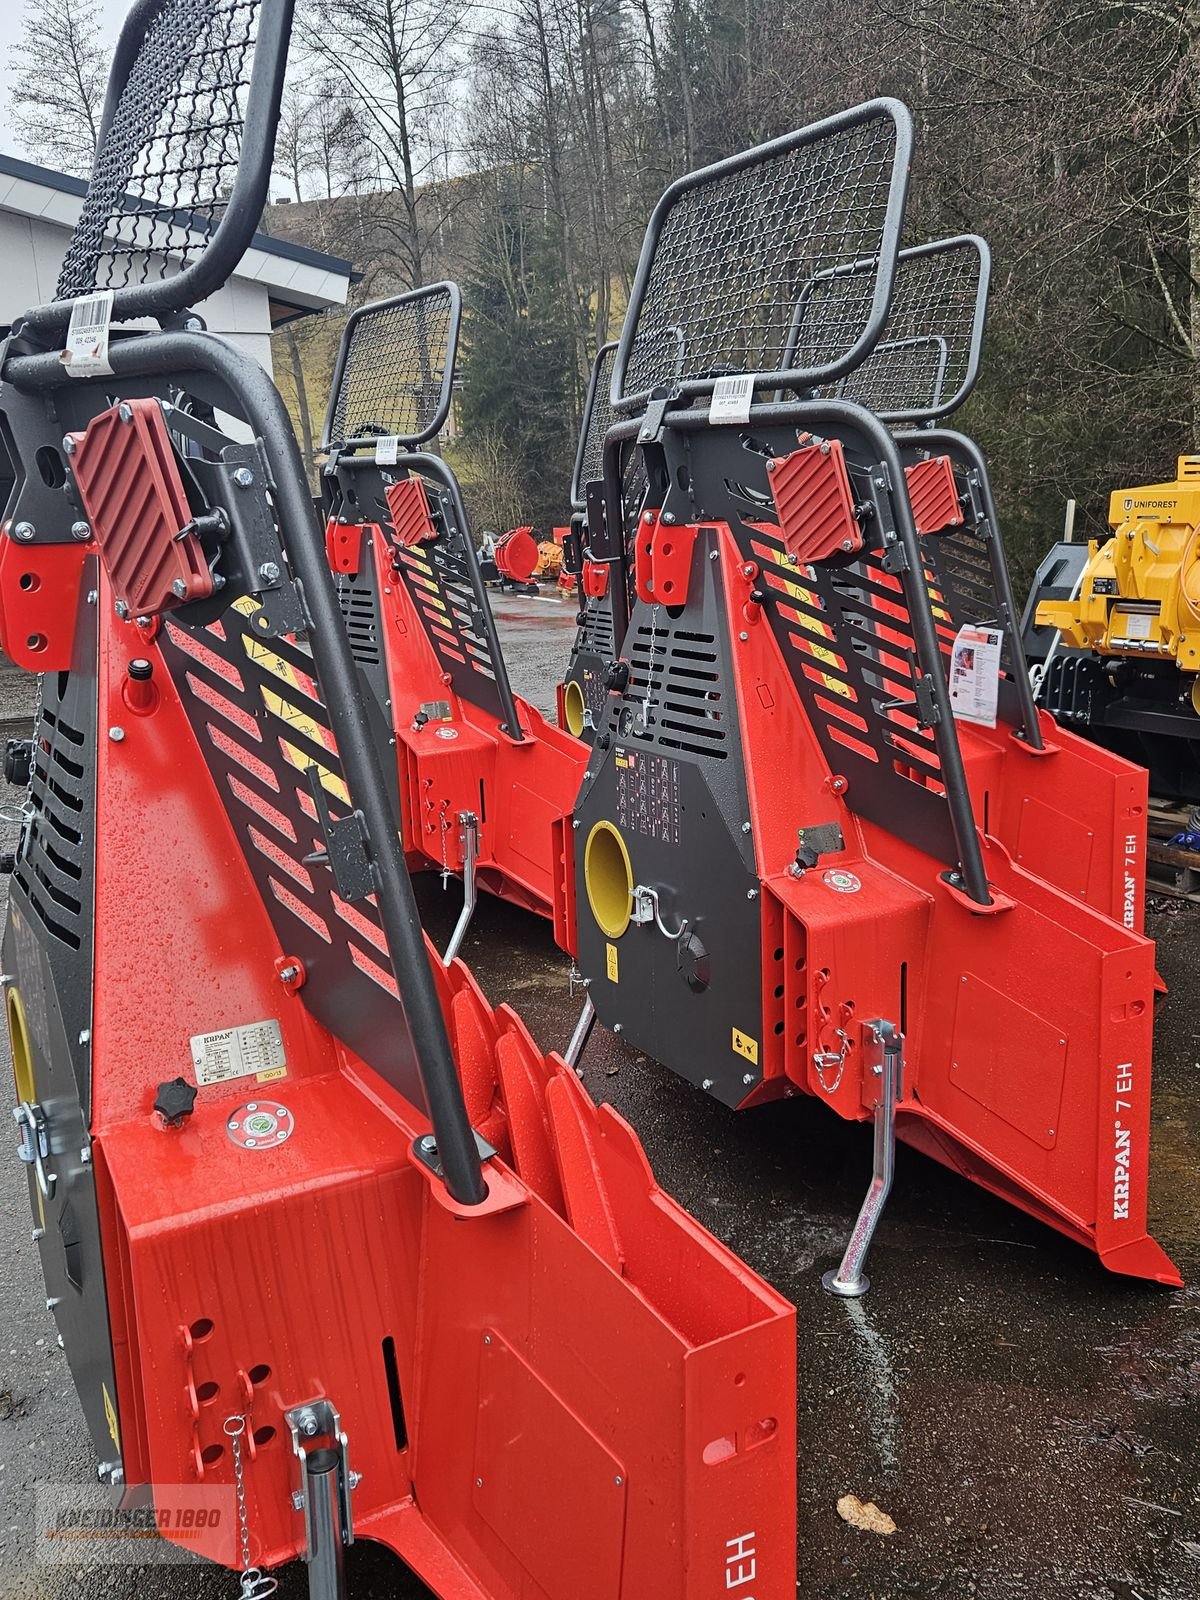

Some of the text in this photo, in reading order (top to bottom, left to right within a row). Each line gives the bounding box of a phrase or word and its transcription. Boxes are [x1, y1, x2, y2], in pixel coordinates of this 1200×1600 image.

[1134, 501, 1178, 509] UNIFOREST
[1125, 835, 1137, 854] EH
[1125, 858, 1136, 867] 7
[1116, 1063, 1132, 1093] EH
[1116, 1100, 1132, 1113] 7
[725, 1531, 756, 1590] EH
